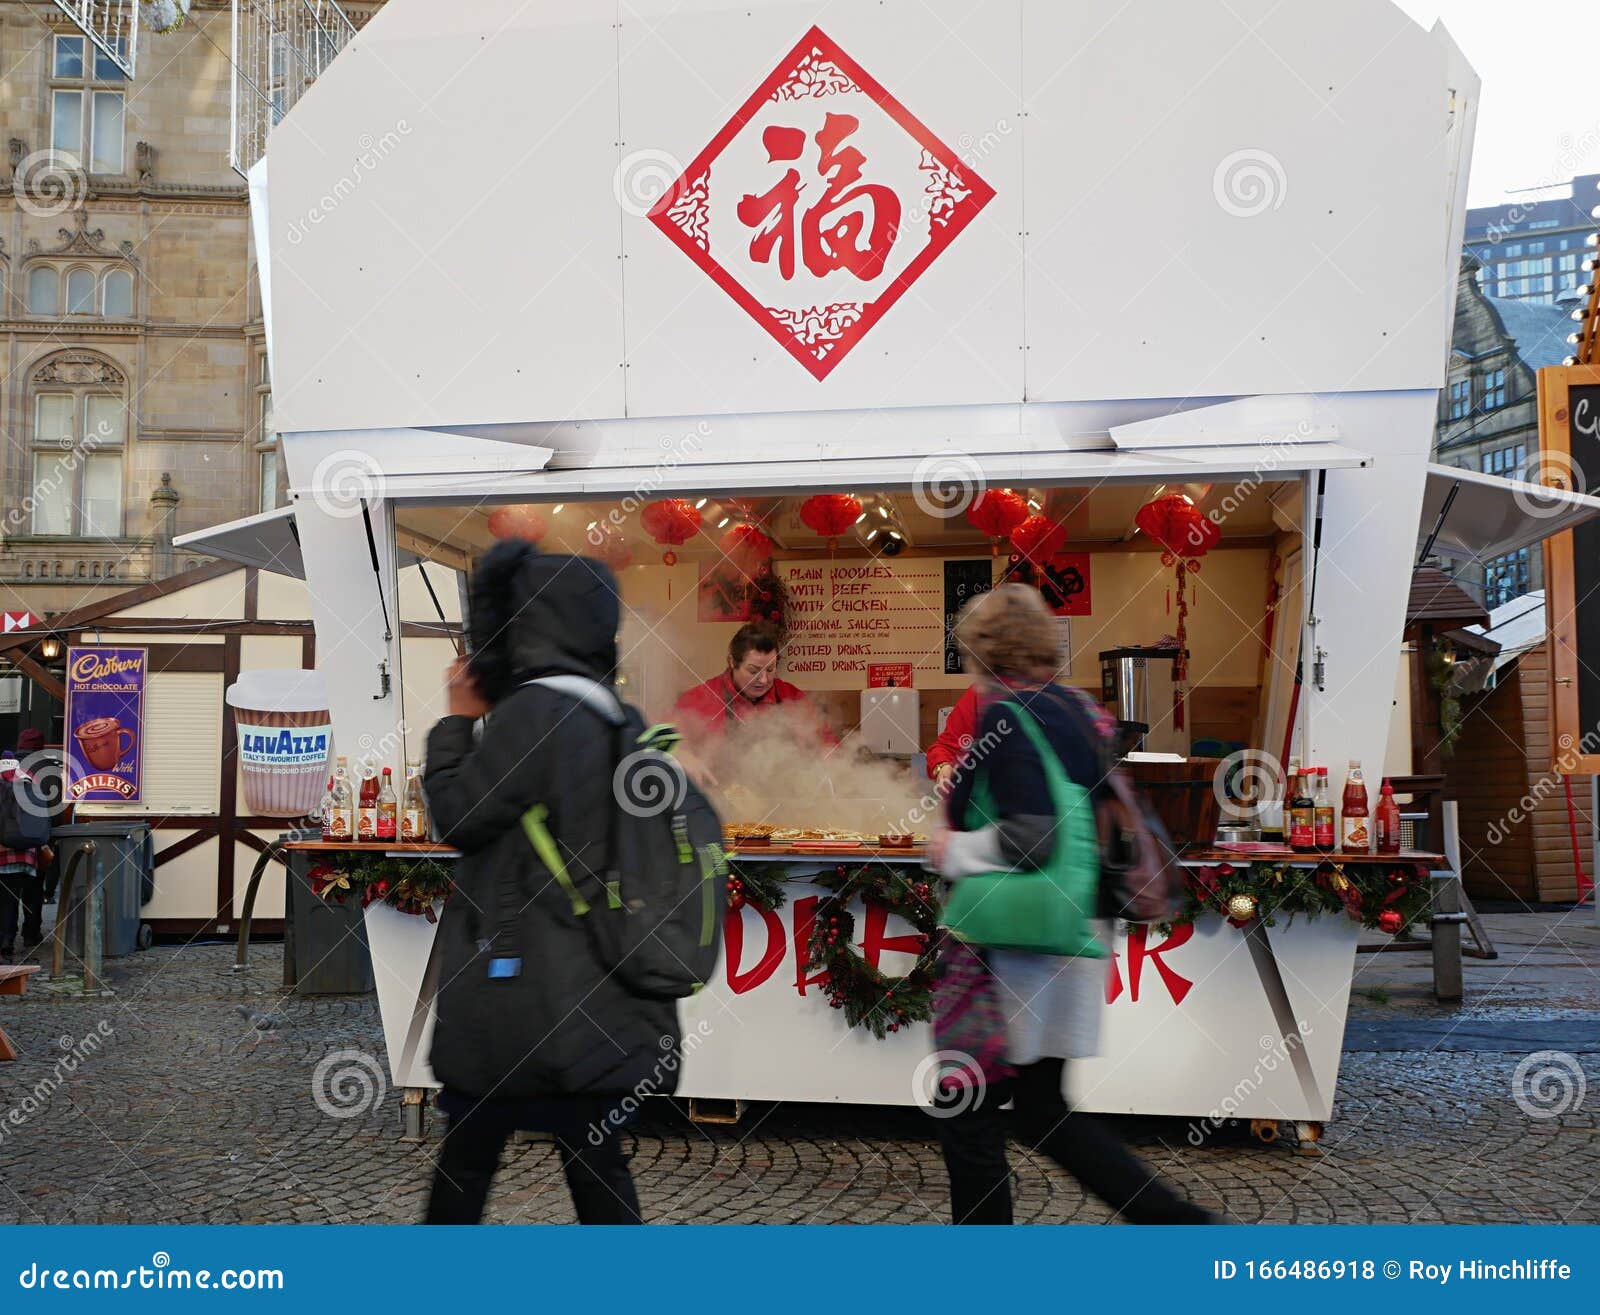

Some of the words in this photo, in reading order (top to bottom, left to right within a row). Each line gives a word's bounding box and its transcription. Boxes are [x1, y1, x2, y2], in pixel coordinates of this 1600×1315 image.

[737, 112, 901, 282] 福
[790, 568, 823, 580] PLAIN
[831, 566, 893, 580] NOODLES
[791, 583, 825, 596] WITH
[832, 583, 872, 596] BEEF
[791, 599, 825, 613] WITH
[831, 599, 889, 612] CHICKEN
[787, 619, 843, 632] ADDITIONAL
[848, 618, 891, 631] SAUCES
[787, 644, 832, 657] BOTTLED
[838, 644, 872, 656] DRINKS
[71, 653, 142, 683] Cadbury
[787, 661, 827, 673] CANNED
[832, 660, 866, 672] DRINKS
[74, 683, 90, 691] HOT
[91, 683, 138, 691] CHOCOLATE
[243, 730, 326, 755] LAVAZZA
[243, 752, 265, 762] ITALY'S
[267, 754, 300, 763] FAVOURITE
[301, 752, 326, 762] COFFEE
[112, 760, 134, 773] With
[243, 765, 272, 774] FRESHLY
[273, 767, 299, 775] GROUND
[300, 764, 326, 774] COFFEE
[73, 775, 132, 795] BAILEYS
